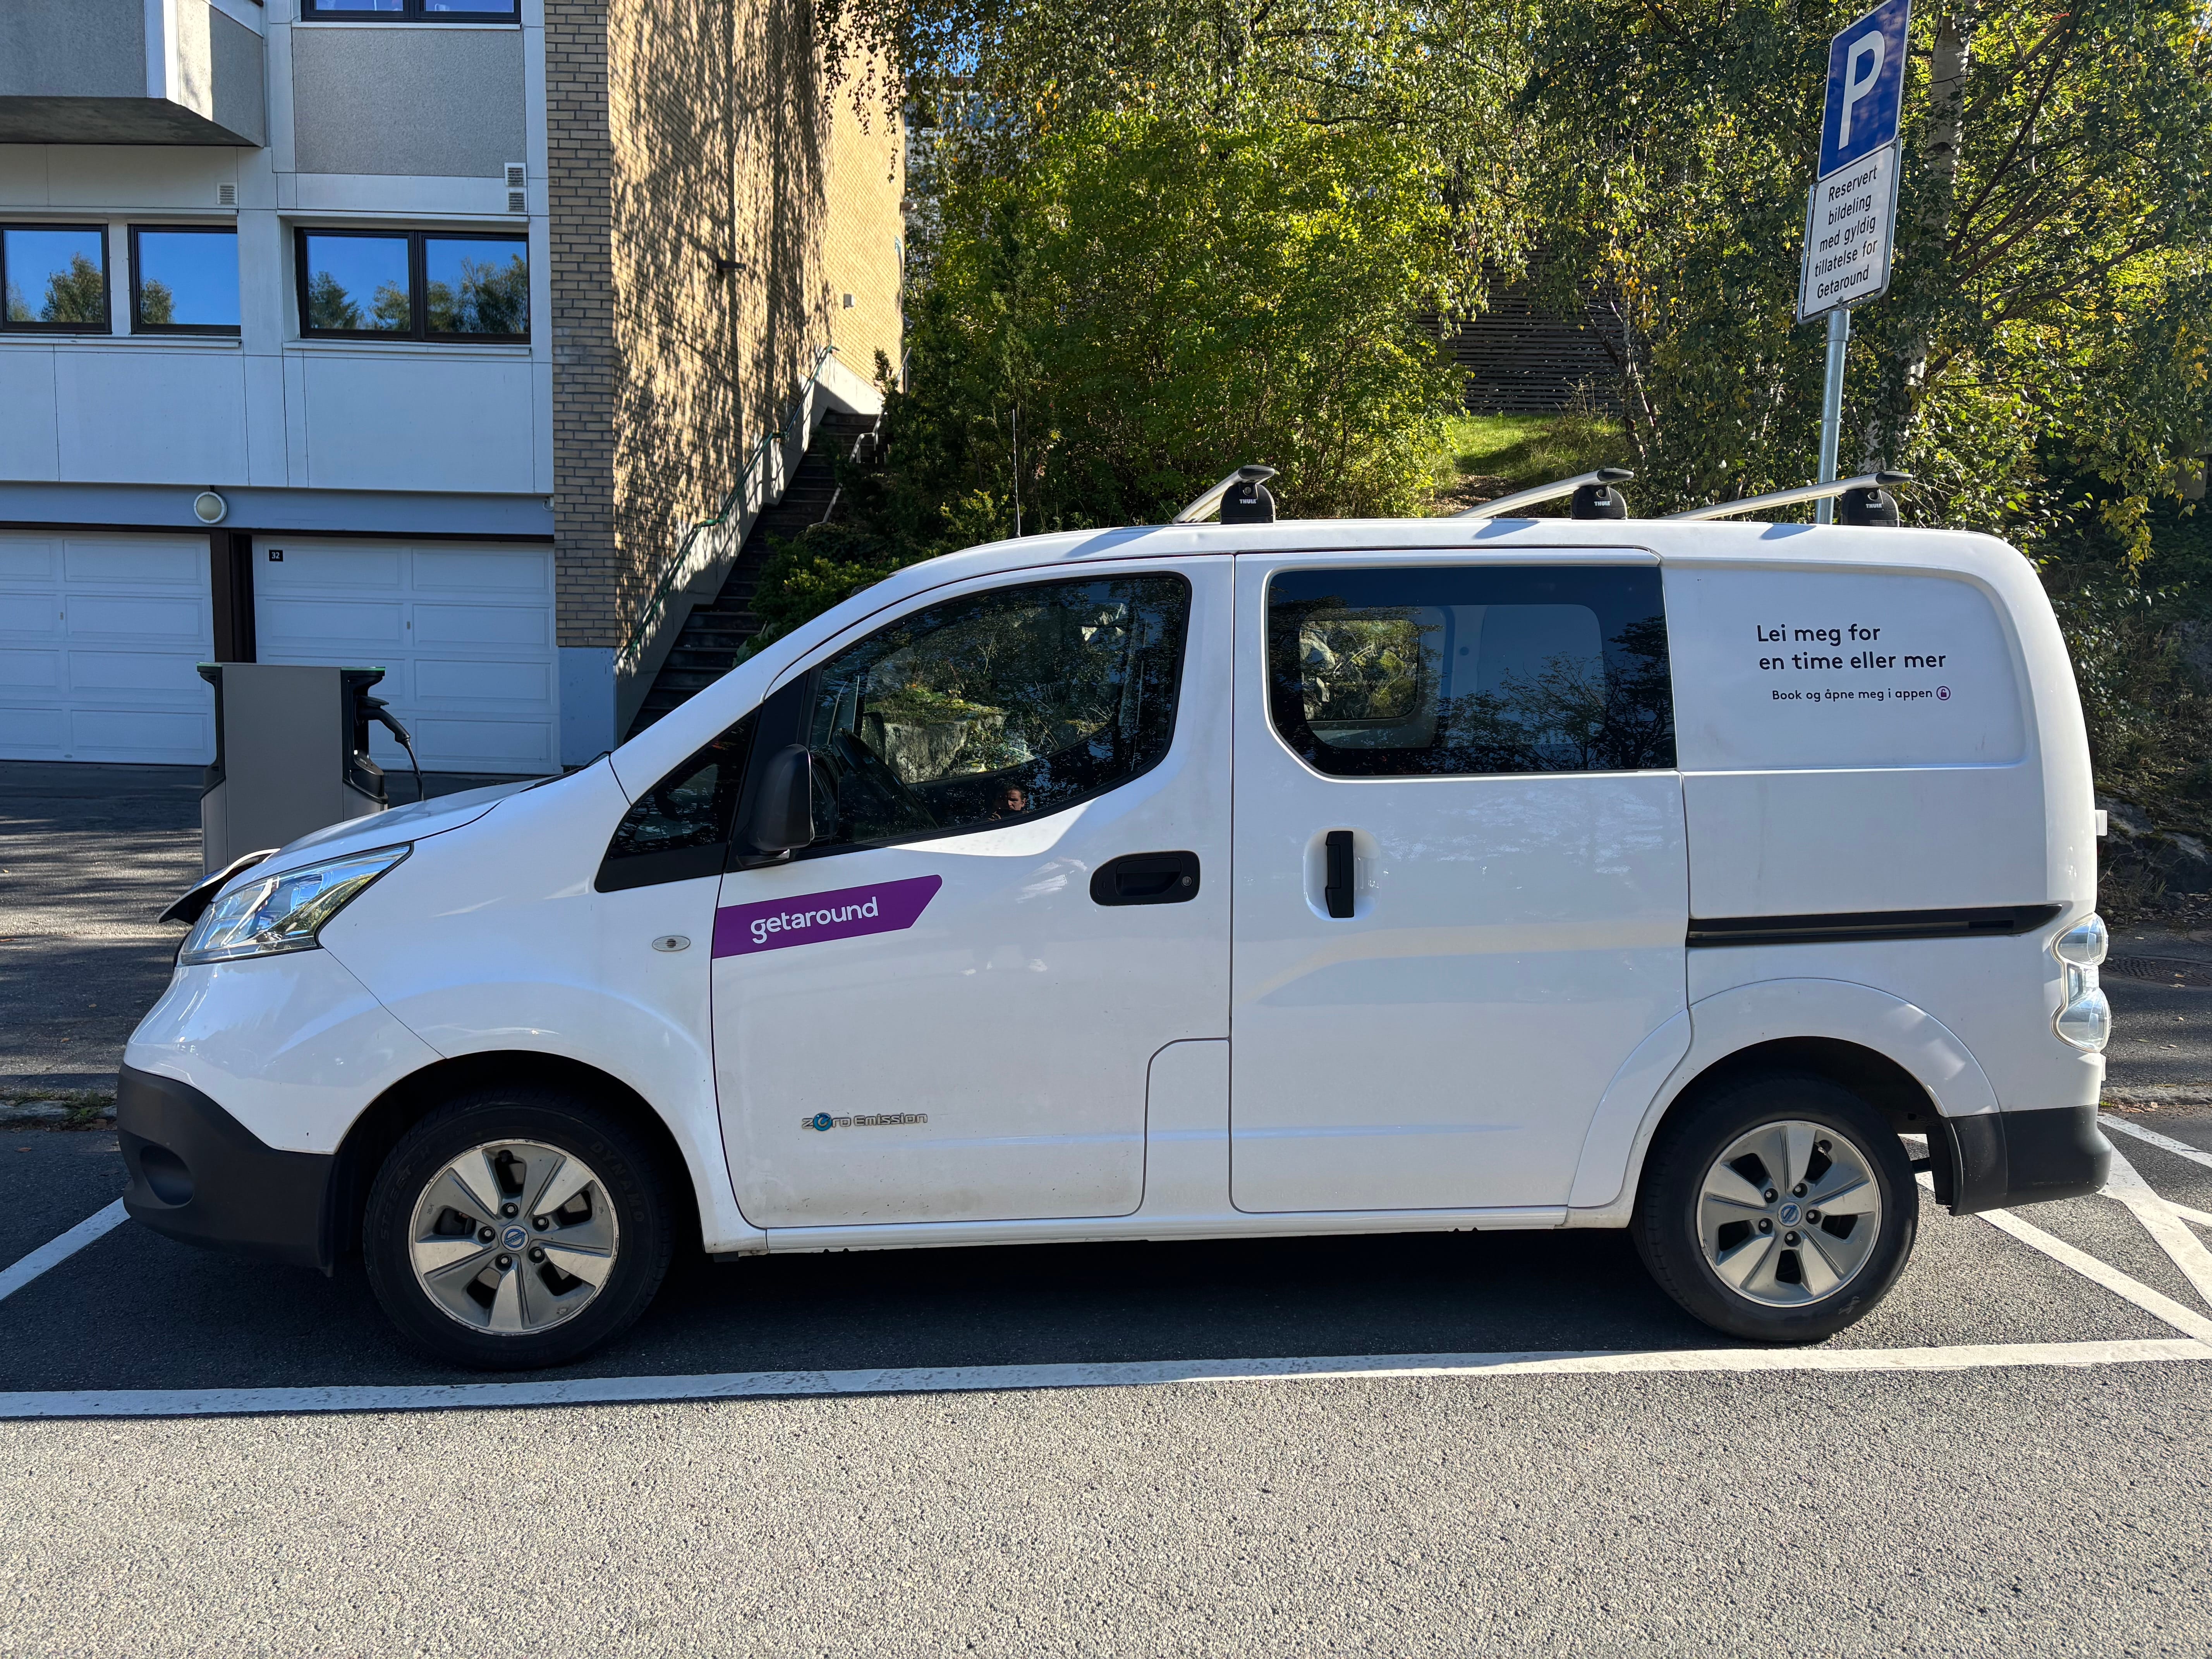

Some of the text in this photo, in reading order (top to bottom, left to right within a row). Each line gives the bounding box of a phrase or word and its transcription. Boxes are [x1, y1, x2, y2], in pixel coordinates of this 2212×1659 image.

[1838, 30, 1885, 150] P
[1828, 165, 1877, 203] Reservert
[1828, 194, 1872, 225] bildeling
[1819, 216, 1876, 252] med gyldig
[1815, 240, 1878, 277] tillatelse for
[1817, 264, 1869, 299] Getaround
[1757, 623, 1881, 647] Lei meg for
[1759, 651, 1946, 670] en time eller mer
[1772, 688, 1932, 702] Book og åpne meg i appen
[750, 896, 879, 944] getaround
[854, 1113, 928, 1126] Emission
[589, 1140, 645, 1222] DYNAMO
